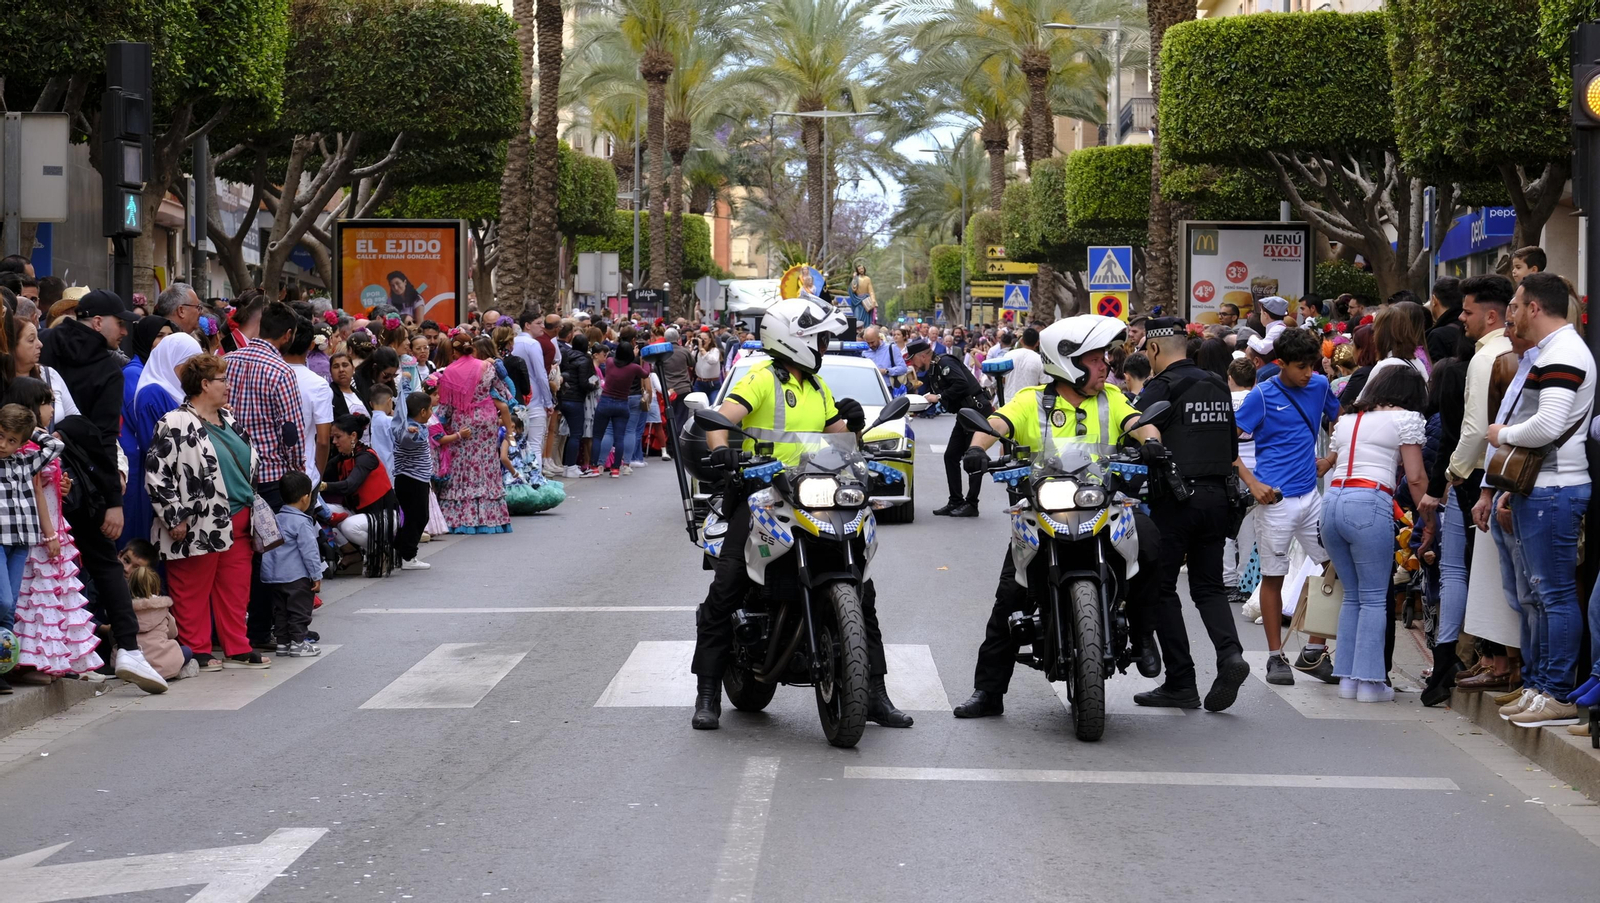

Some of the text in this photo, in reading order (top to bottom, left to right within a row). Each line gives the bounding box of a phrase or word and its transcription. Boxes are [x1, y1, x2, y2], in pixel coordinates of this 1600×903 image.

[1490, 209, 1517, 218] pepc
[1264, 232, 1301, 245] MENÚ
[356, 239, 441, 253] EL EJIDO
[1264, 245, 1301, 257] 4YOU
[1185, 401, 1230, 412] POLICIA
[1191, 412, 1229, 423] LOCAL
